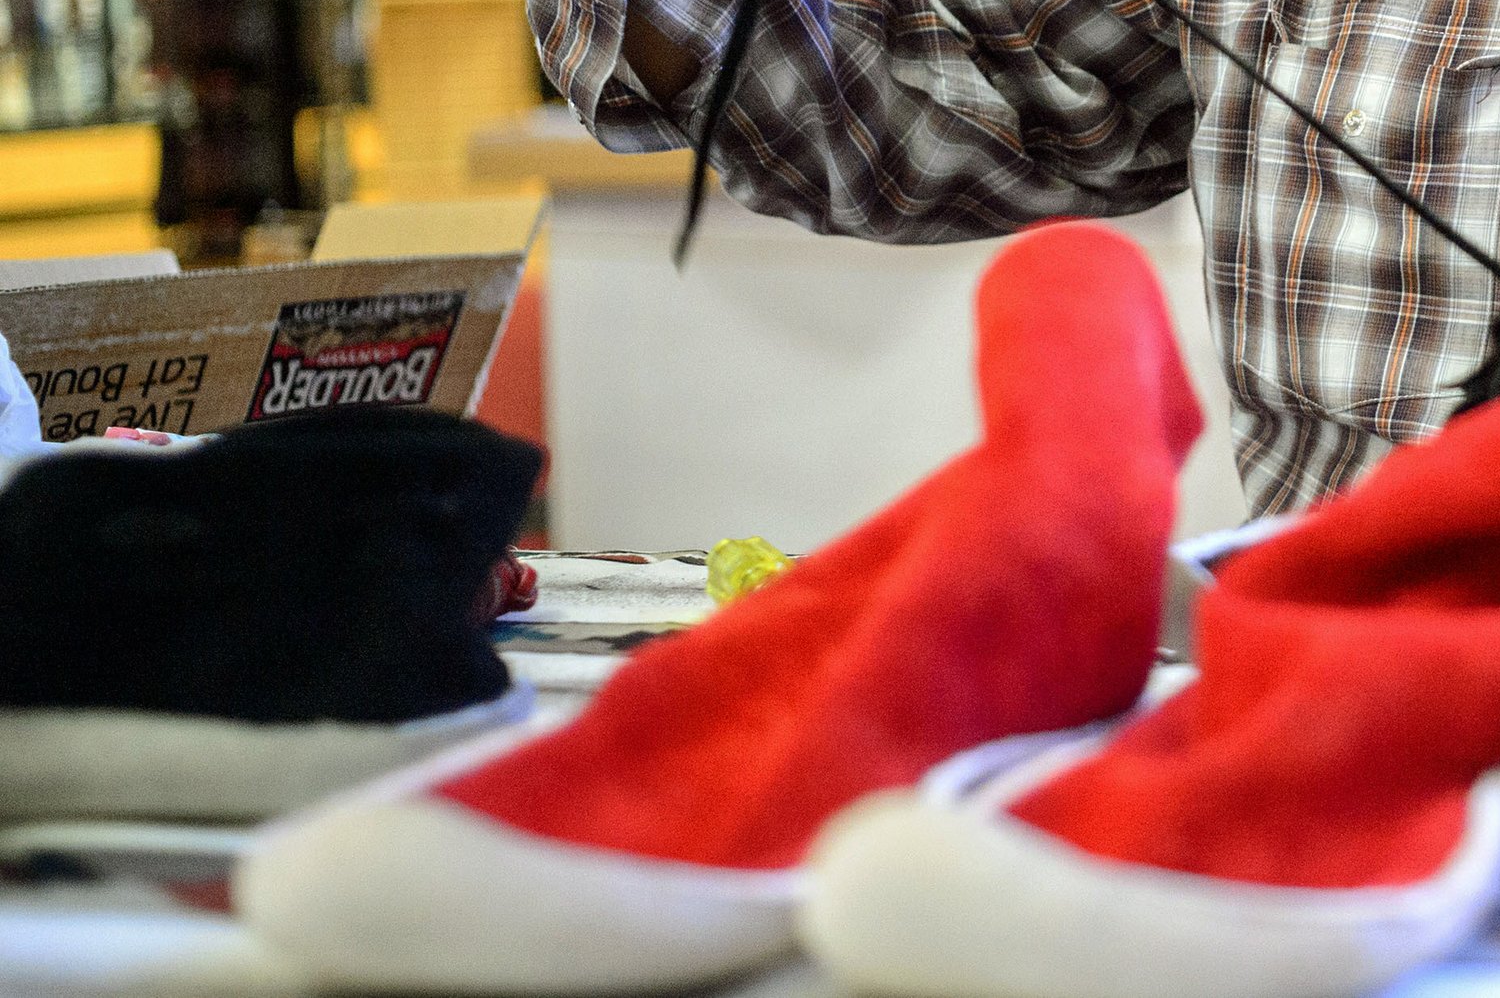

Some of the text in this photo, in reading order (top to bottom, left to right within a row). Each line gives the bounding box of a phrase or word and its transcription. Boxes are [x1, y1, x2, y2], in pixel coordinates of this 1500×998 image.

[138, 353, 209, 399] Eat
[262, 345, 439, 414] BOULDER
[112, 398, 195, 436] Live
